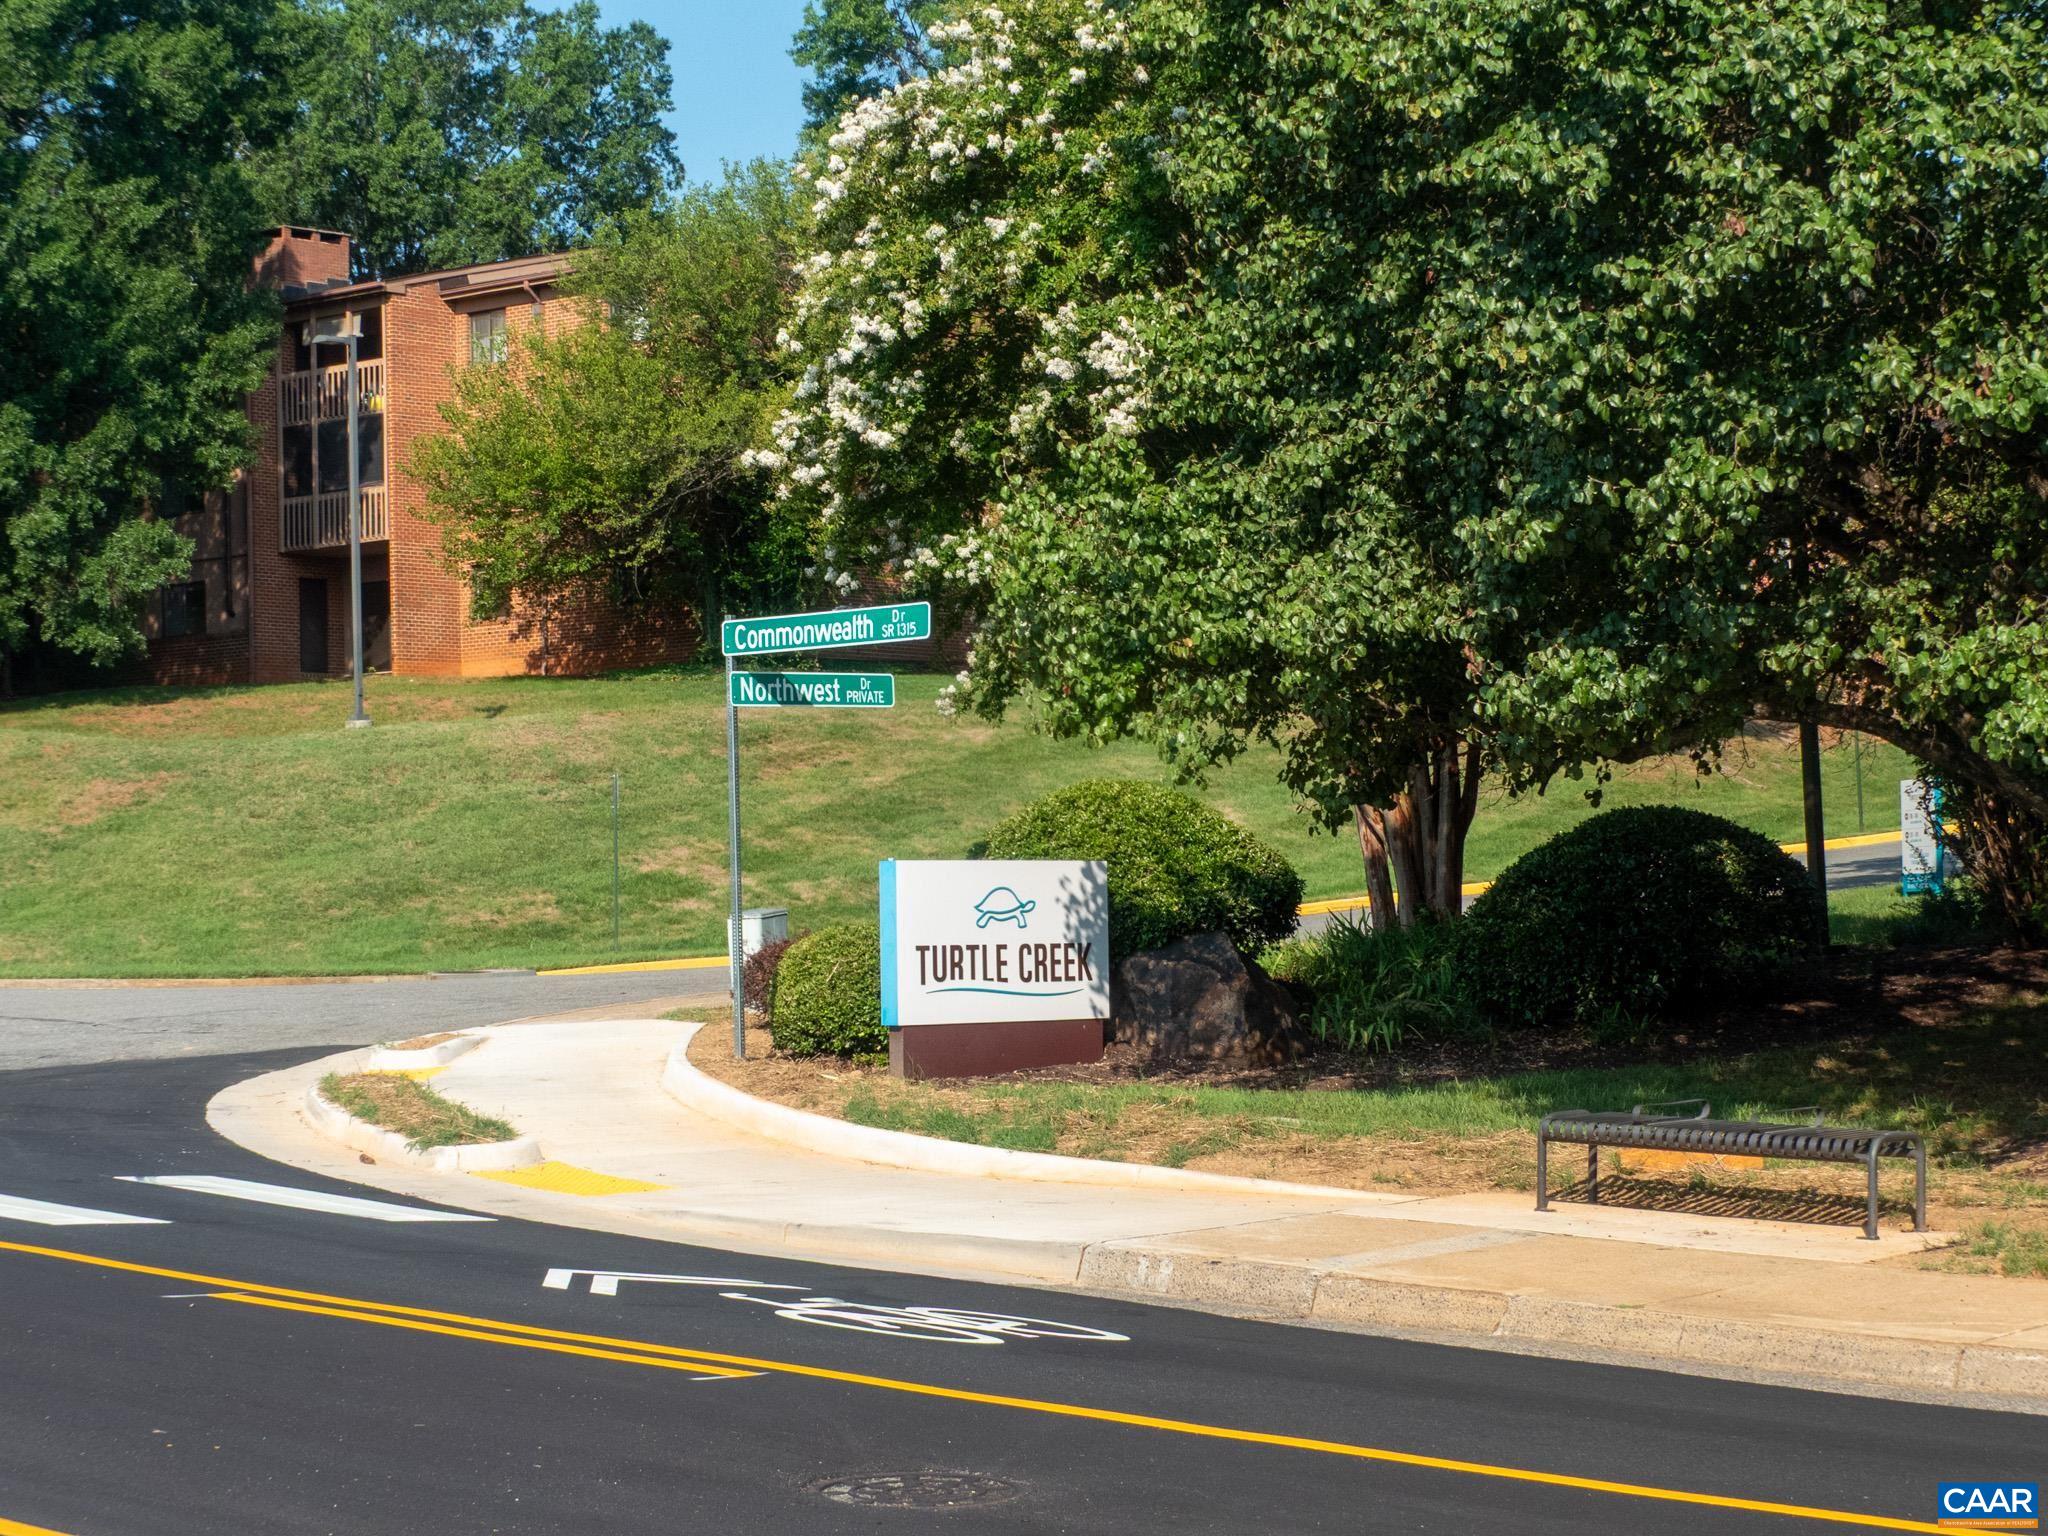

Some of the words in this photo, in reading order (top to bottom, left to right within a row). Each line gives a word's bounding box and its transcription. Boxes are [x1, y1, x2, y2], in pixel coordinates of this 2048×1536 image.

[734, 614, 874, 650] Commonwealth
[892, 609, 906, 623] Dr
[881, 624, 894, 638] SR
[897, 621, 917, 637] 1315
[740, 677, 840, 702] Northwest
[860, 678, 871, 690] Dr
[846, 690, 885, 704] PRIVATE
[915, 943, 1008, 985] TURTLE
[1018, 942, 1093, 982] CREEK
